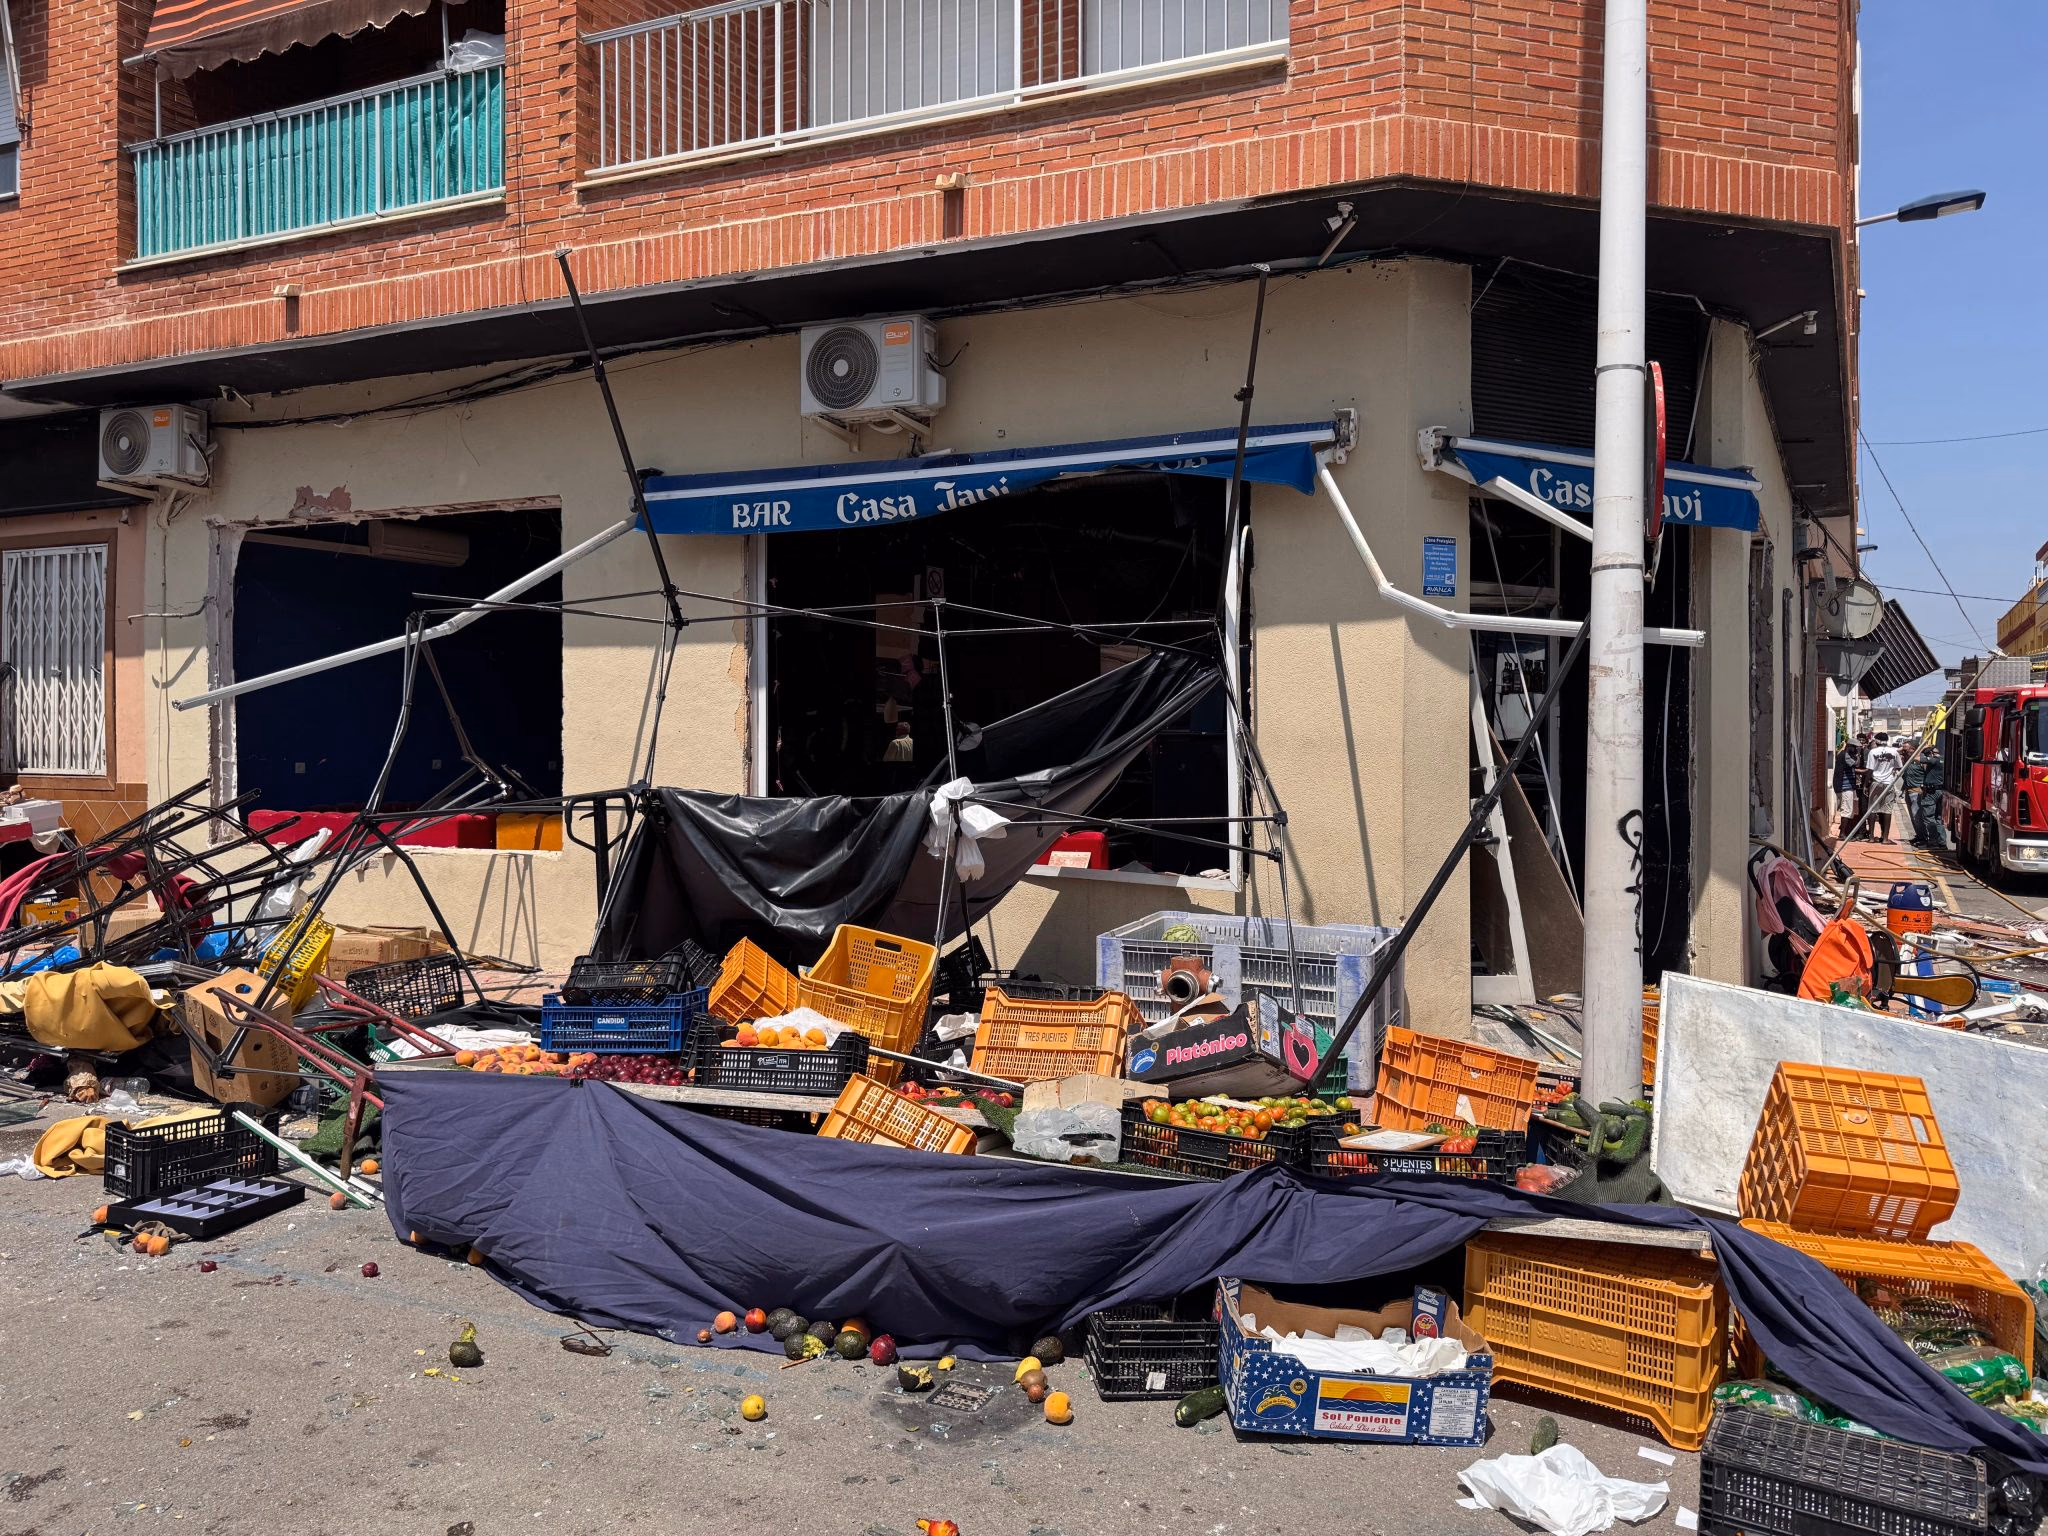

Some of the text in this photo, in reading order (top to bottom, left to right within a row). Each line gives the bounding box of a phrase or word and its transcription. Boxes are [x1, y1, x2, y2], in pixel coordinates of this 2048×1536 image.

[1529, 467, 1703, 521] Cas avi
[732, 500, 792, 528] BAR
[836, 492, 918, 524] Casa
[1024, 1031, 1068, 1043] TRES PUENTES
[1166, 1032, 1248, 1066] Platónico
[1383, 1157, 1432, 1170] 3 PUENTES
[1322, 1411, 1402, 1425] Sol Poniente
[1329, 1421, 1353, 1430] Calidad
